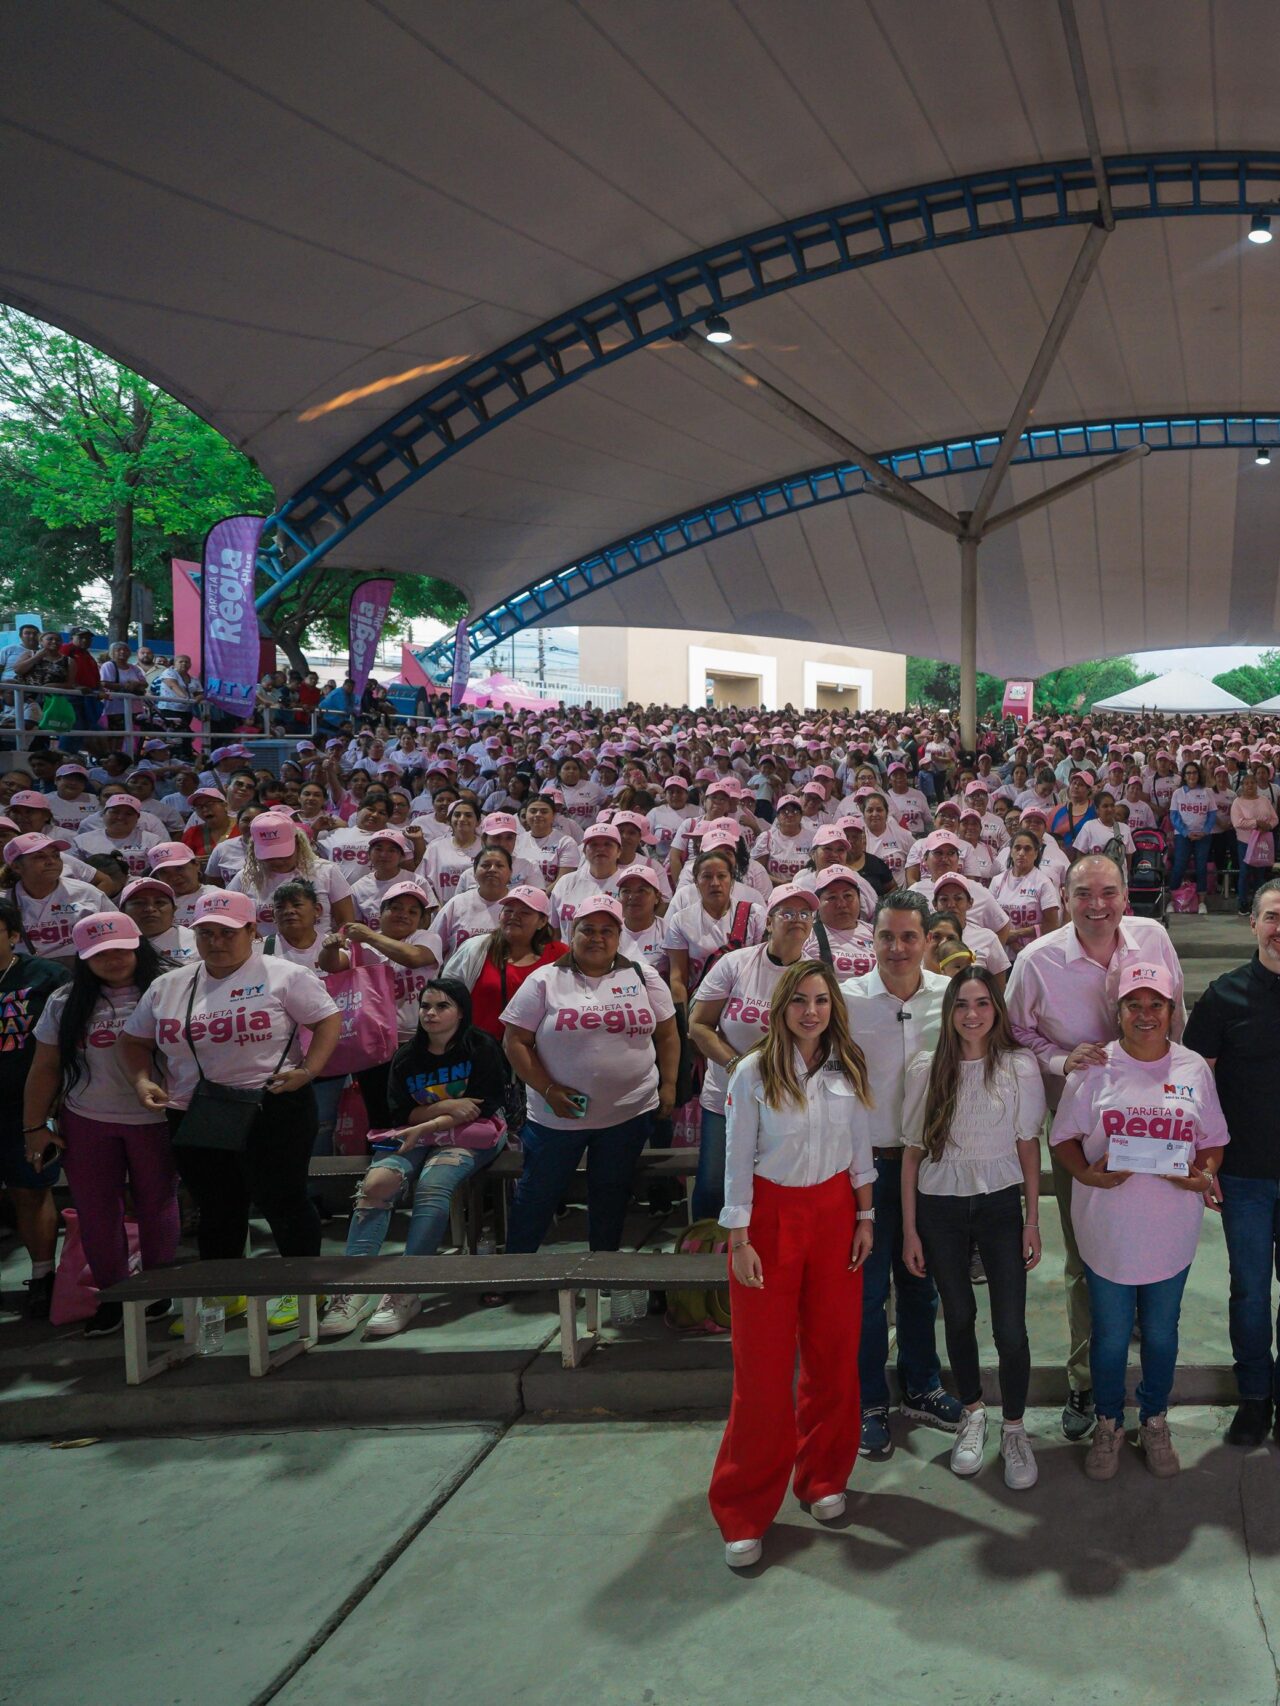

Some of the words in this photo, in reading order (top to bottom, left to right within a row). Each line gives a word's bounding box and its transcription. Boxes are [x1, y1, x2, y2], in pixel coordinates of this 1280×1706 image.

[208, 548, 247, 645] Regia
[207, 676, 252, 698] MTY
[1181, 803, 1208, 813] Regia
[333, 846, 370, 865] Reg
[769, 860, 805, 877] Regi
[832, 953, 877, 976] egi
[1133, 969, 1157, 977] MTY
[230, 984, 265, 998] MTY
[612, 985, 638, 995] MTY
[581, 1003, 622, 1012] TARJETA
[746, 998, 772, 1008] TARJE
[555, 1003, 653, 1034] Regia
[724, 998, 771, 1034] Reg
[159, 1007, 272, 1044] Regia
[1163, 1084, 1194, 1097] MTY
[1126, 1107, 1172, 1116] TARJETA
[1102, 1108, 1194, 1142] Regia
